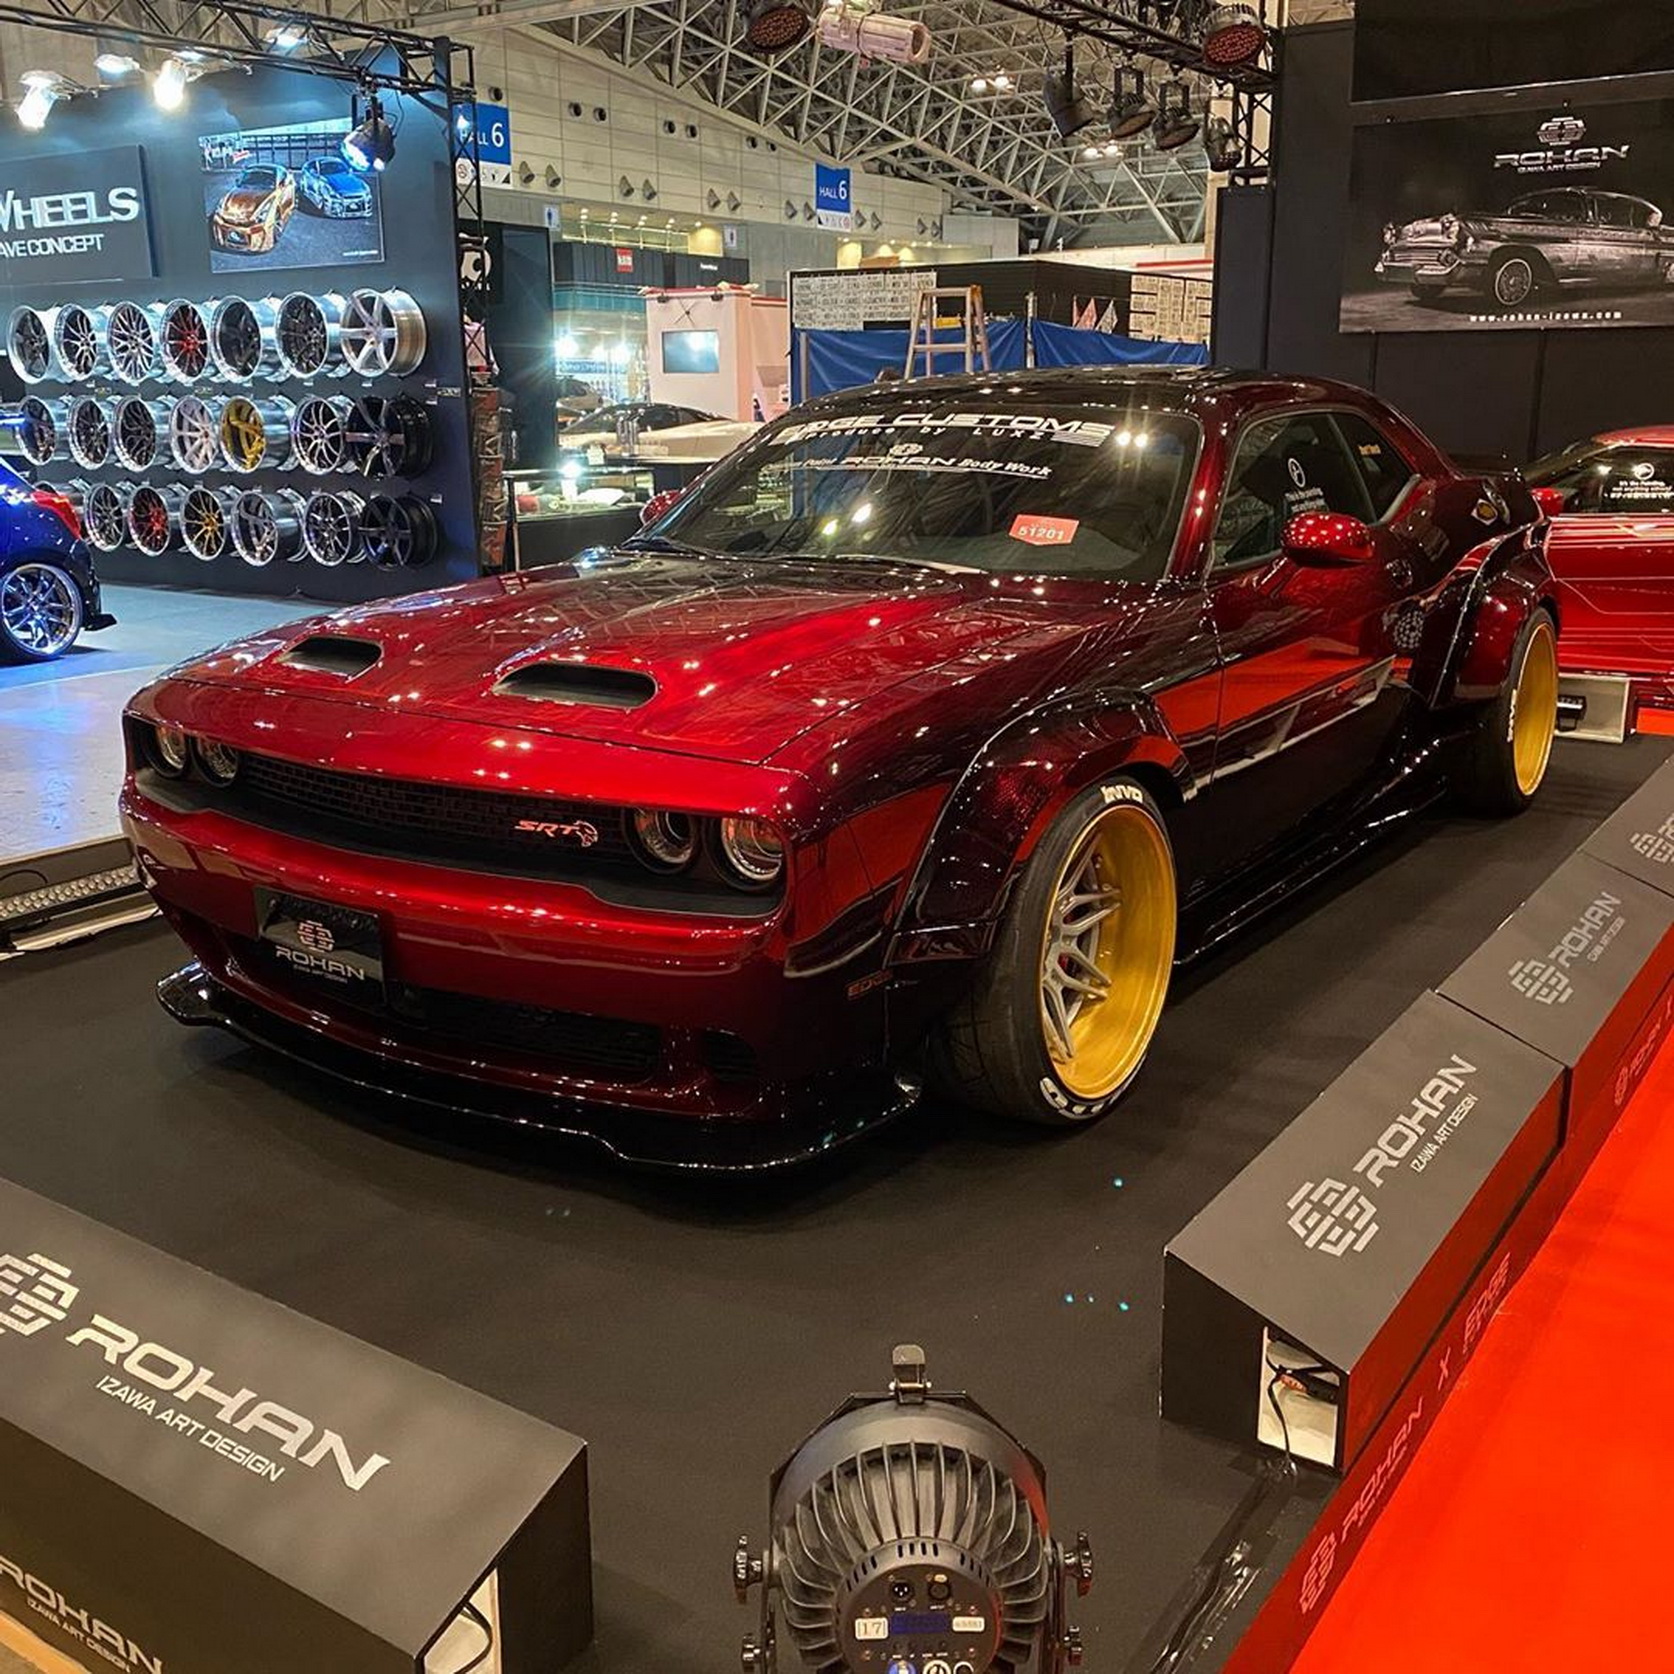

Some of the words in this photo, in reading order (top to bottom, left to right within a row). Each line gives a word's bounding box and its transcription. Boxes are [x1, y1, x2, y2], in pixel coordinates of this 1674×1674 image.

[491, 122, 505, 148] 6
[1493, 145, 1630, 168] ROHAN
[819, 187, 838, 200] HALL
[838, 180, 848, 200] 6
[27, 234, 105, 256] CONCEPT
[766, 414, 885, 446] EDGE
[892, 412, 1116, 440] CUSTOMS
[919, 427, 946, 436] by
[840, 456, 957, 467] ROHAN
[957, 458, 1003, 471] Body
[1004, 462, 1052, 476] Work
[514, 820, 580, 838] SRT
[1548, 891, 1622, 969] ROHAN
[275, 945, 365, 980] ROHAN
[1352, 1054, 1477, 1188] ROHAN
[1409, 1142, 1440, 1173] IZAWA
[1432, 1121, 1454, 1146] ART
[1446, 1093, 1479, 1127] DESIGN
[65, 1314, 391, 1491] ROHAN
[97, 1375, 157, 1415] IZAWA
[155, 1410, 205, 1437] ART
[199, 1430, 286, 1482] DESIGN
[1340, 1395, 1424, 1544] ROHAN
[0, 1555, 163, 1674] ROHAN
